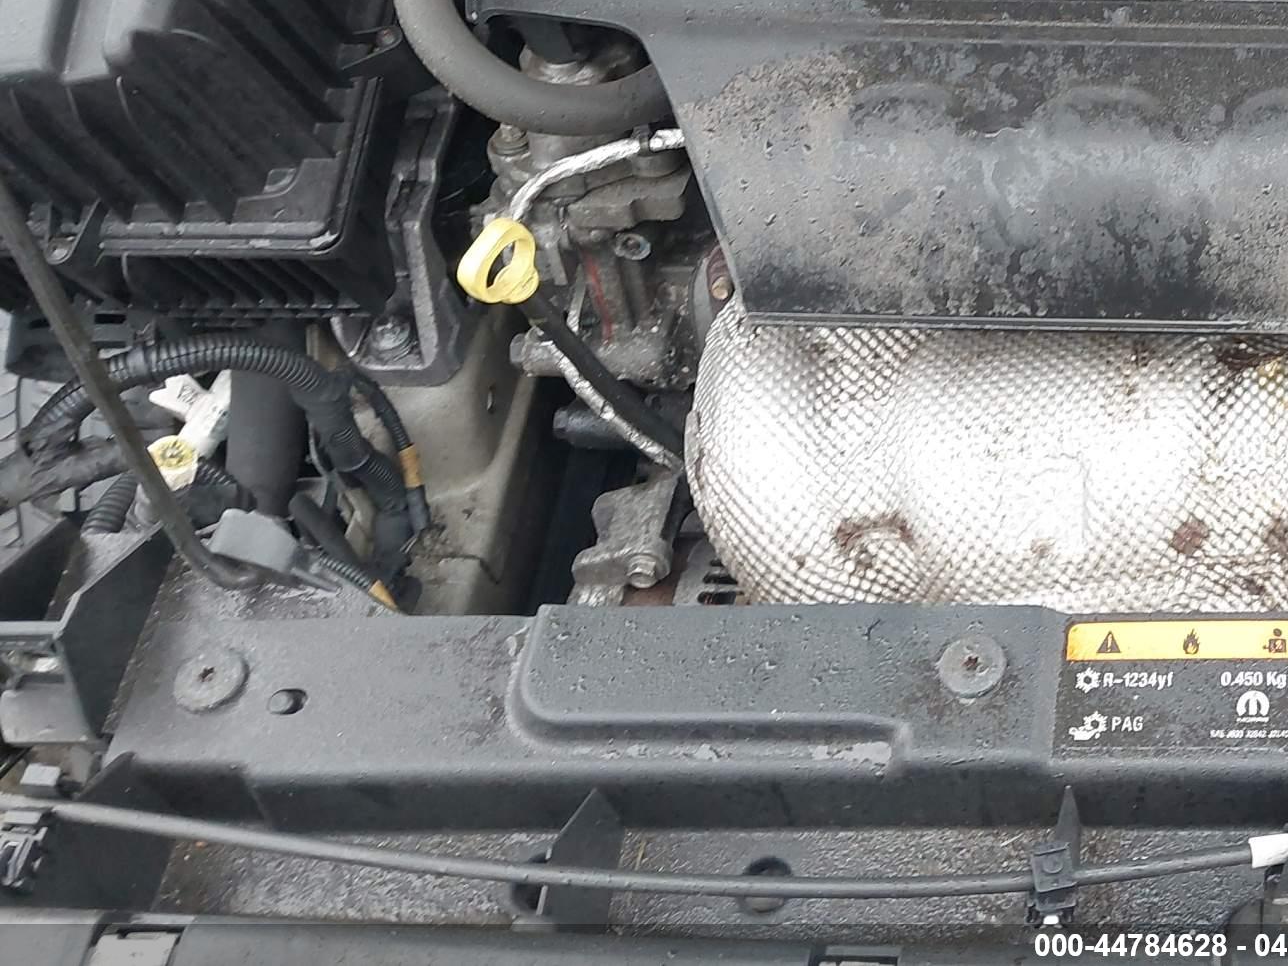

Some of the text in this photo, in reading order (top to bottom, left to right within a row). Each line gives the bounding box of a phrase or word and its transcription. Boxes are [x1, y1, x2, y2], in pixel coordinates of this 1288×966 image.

[1103, 671, 1174, 690] R-1234yf
[1220, 671, 1287, 690] 0.450 Kg
[1111, 716, 1144, 732] PAG
